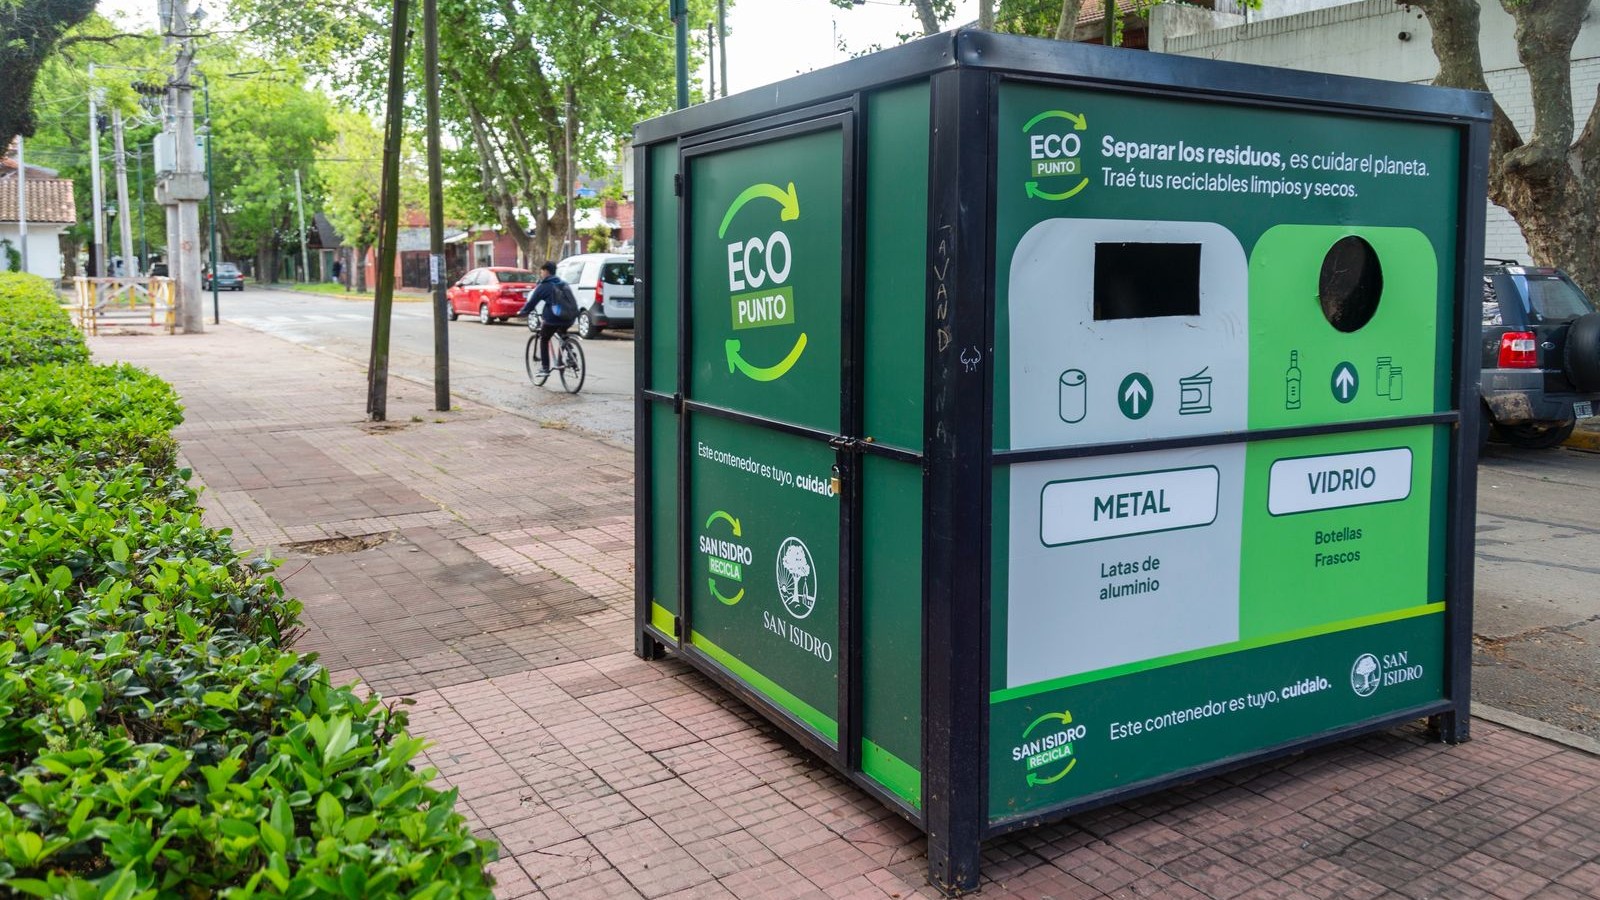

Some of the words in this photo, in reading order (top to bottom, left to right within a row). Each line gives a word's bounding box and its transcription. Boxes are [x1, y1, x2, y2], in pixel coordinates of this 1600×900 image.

[1030, 133, 1081, 159] ECO
[1101, 135, 1176, 163] Separar
[1178, 141, 1205, 163] los
[1208, 145, 1286, 171] residuos,
[1290, 153, 1309, 169] es
[1311, 152, 1359, 171] cuidar
[1360, 154, 1372, 173] el
[1374, 155, 1430, 178] planeta.
[1037, 161, 1076, 175] PUNTO
[1101, 167, 1136, 187] Traé
[1140, 172, 1165, 189] tus
[1166, 174, 1248, 193] reciclables
[1251, 175, 1301, 198] limpios
[1303, 182, 1313, 200] y
[1314, 182, 1358, 198] secos.
[727, 230, 792, 292] ECO
[738, 295, 786, 324] PUNTO
[698, 441, 713, 460] Este
[713, 450, 760, 474] contenedor
[761, 464, 771, 478] es
[772, 466, 795, 488] tuyo,
[1307, 466, 1376, 495] VIDRIO
[1093, 489, 1171, 522] METAL
[700, 535, 718, 556] SAN
[718, 540, 753, 566] ISIDRO
[1315, 527, 1362, 545] Botellas
[710, 558, 741, 579] RECICLA
[1101, 560, 1139, 579] Latas
[1142, 555, 1160, 572] de
[1315, 550, 1361, 568] Frascos
[1099, 578, 1160, 600] aluminio
[763, 610, 786, 639] SAN
[789, 624, 832, 662] ISIDRO
[1383, 651, 1408, 669] SAN
[1383, 664, 1423, 687] ISIDRO
[1110, 721, 1143, 741] Este
[1145, 700, 1228, 733] contenedor
[1228, 696, 1245, 712] es
[1246, 689, 1280, 709] tuyo,
[1281, 675, 1332, 699] cuidalo.
[1012, 741, 1041, 761] SAN
[1042, 724, 1087, 751] ISIDRO
[1029, 745, 1072, 768] RECICLA
